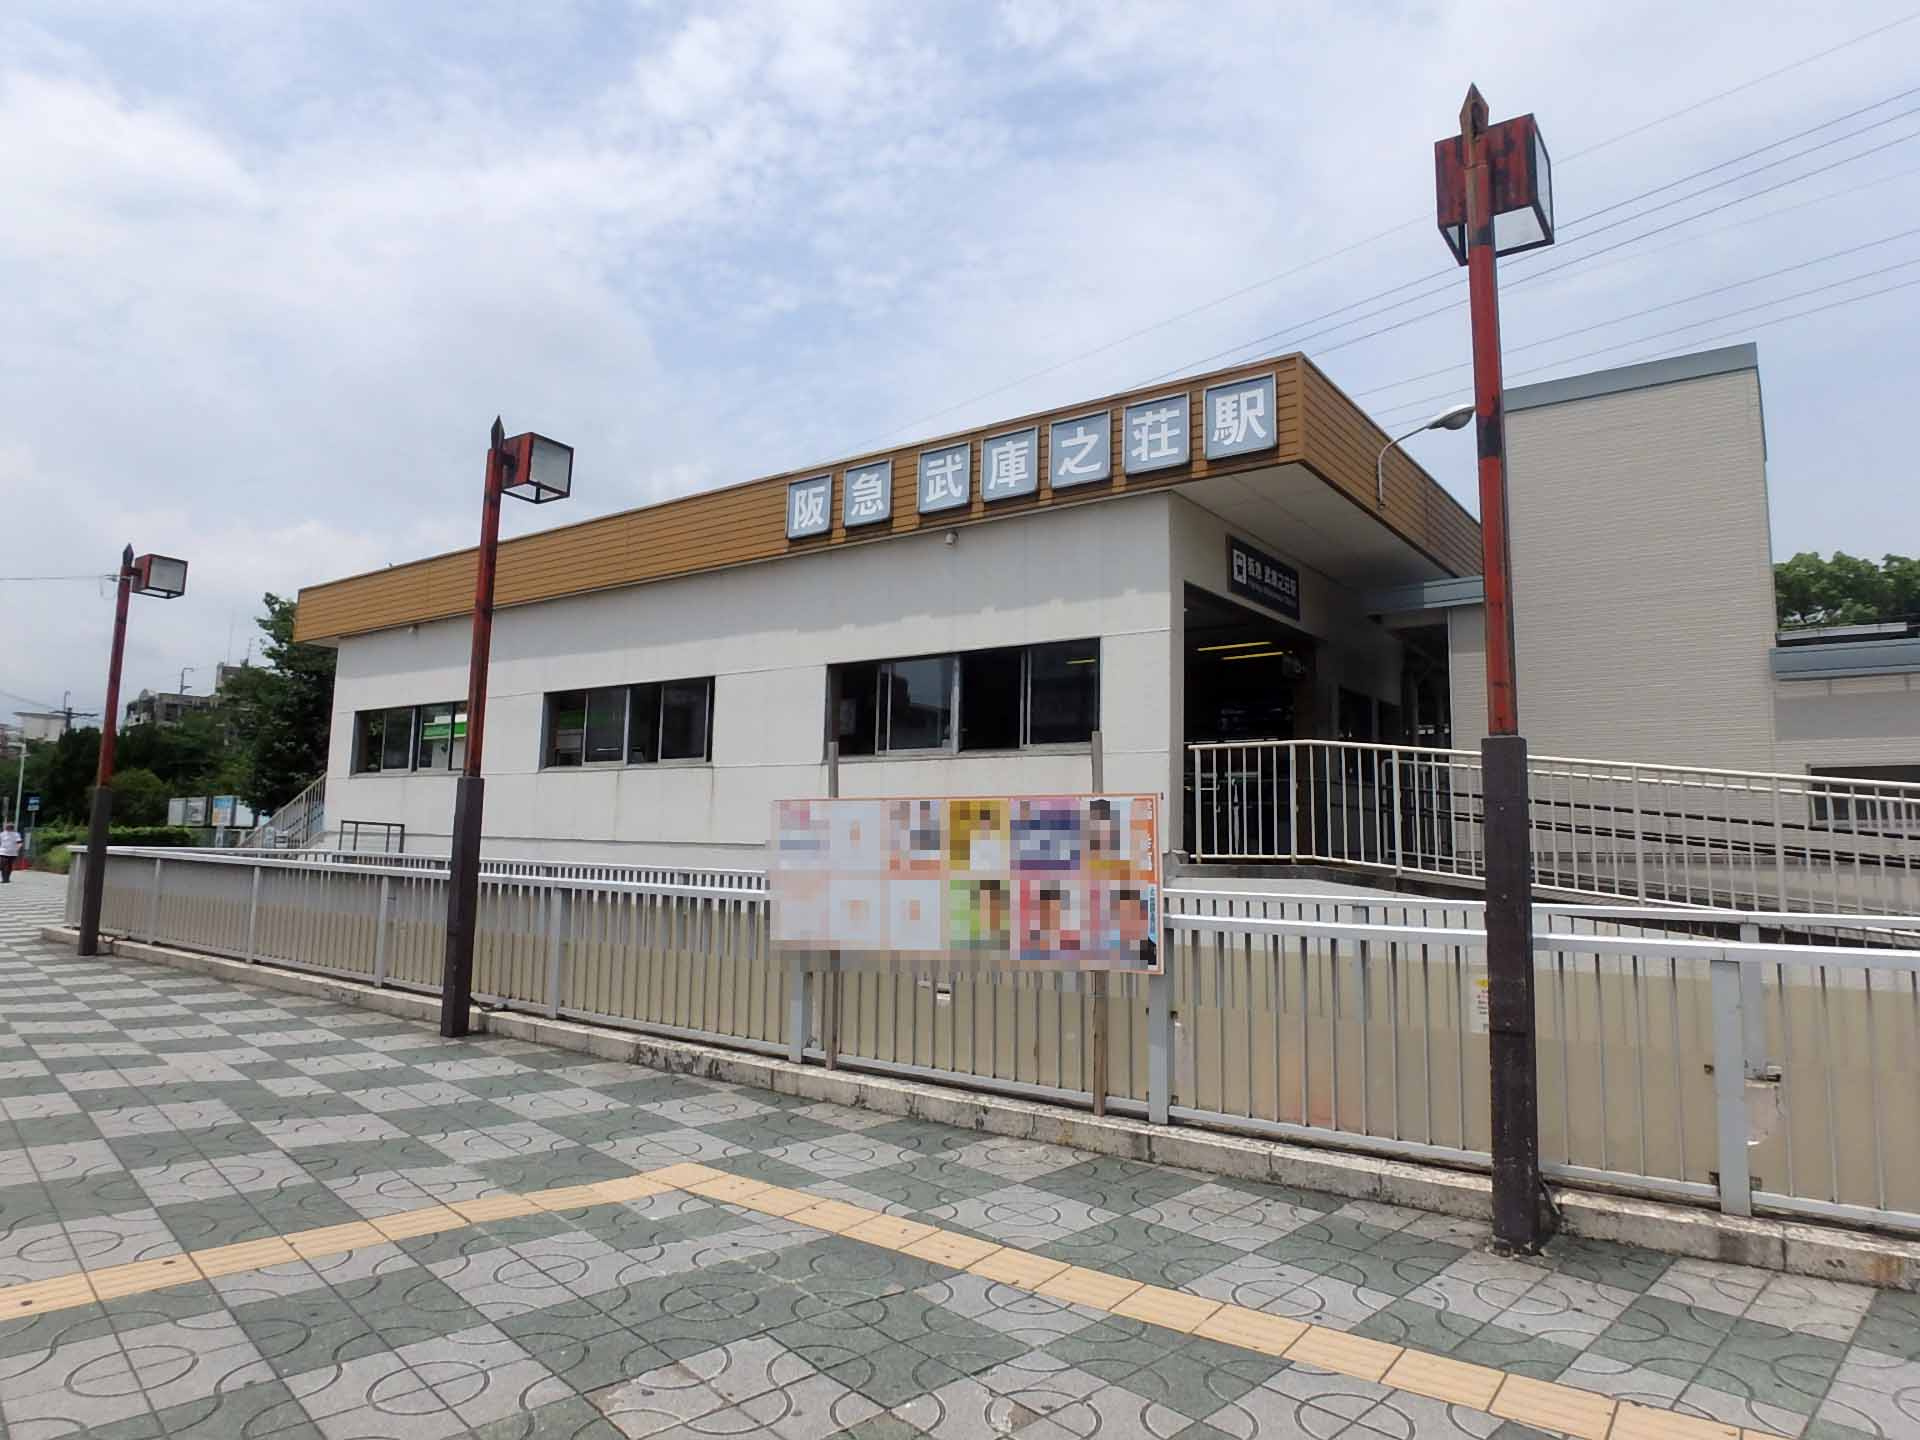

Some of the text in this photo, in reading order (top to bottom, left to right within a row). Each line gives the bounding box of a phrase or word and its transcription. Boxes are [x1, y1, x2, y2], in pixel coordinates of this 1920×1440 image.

[793, 387, 1267, 529] 阪急武庫之荘駅
